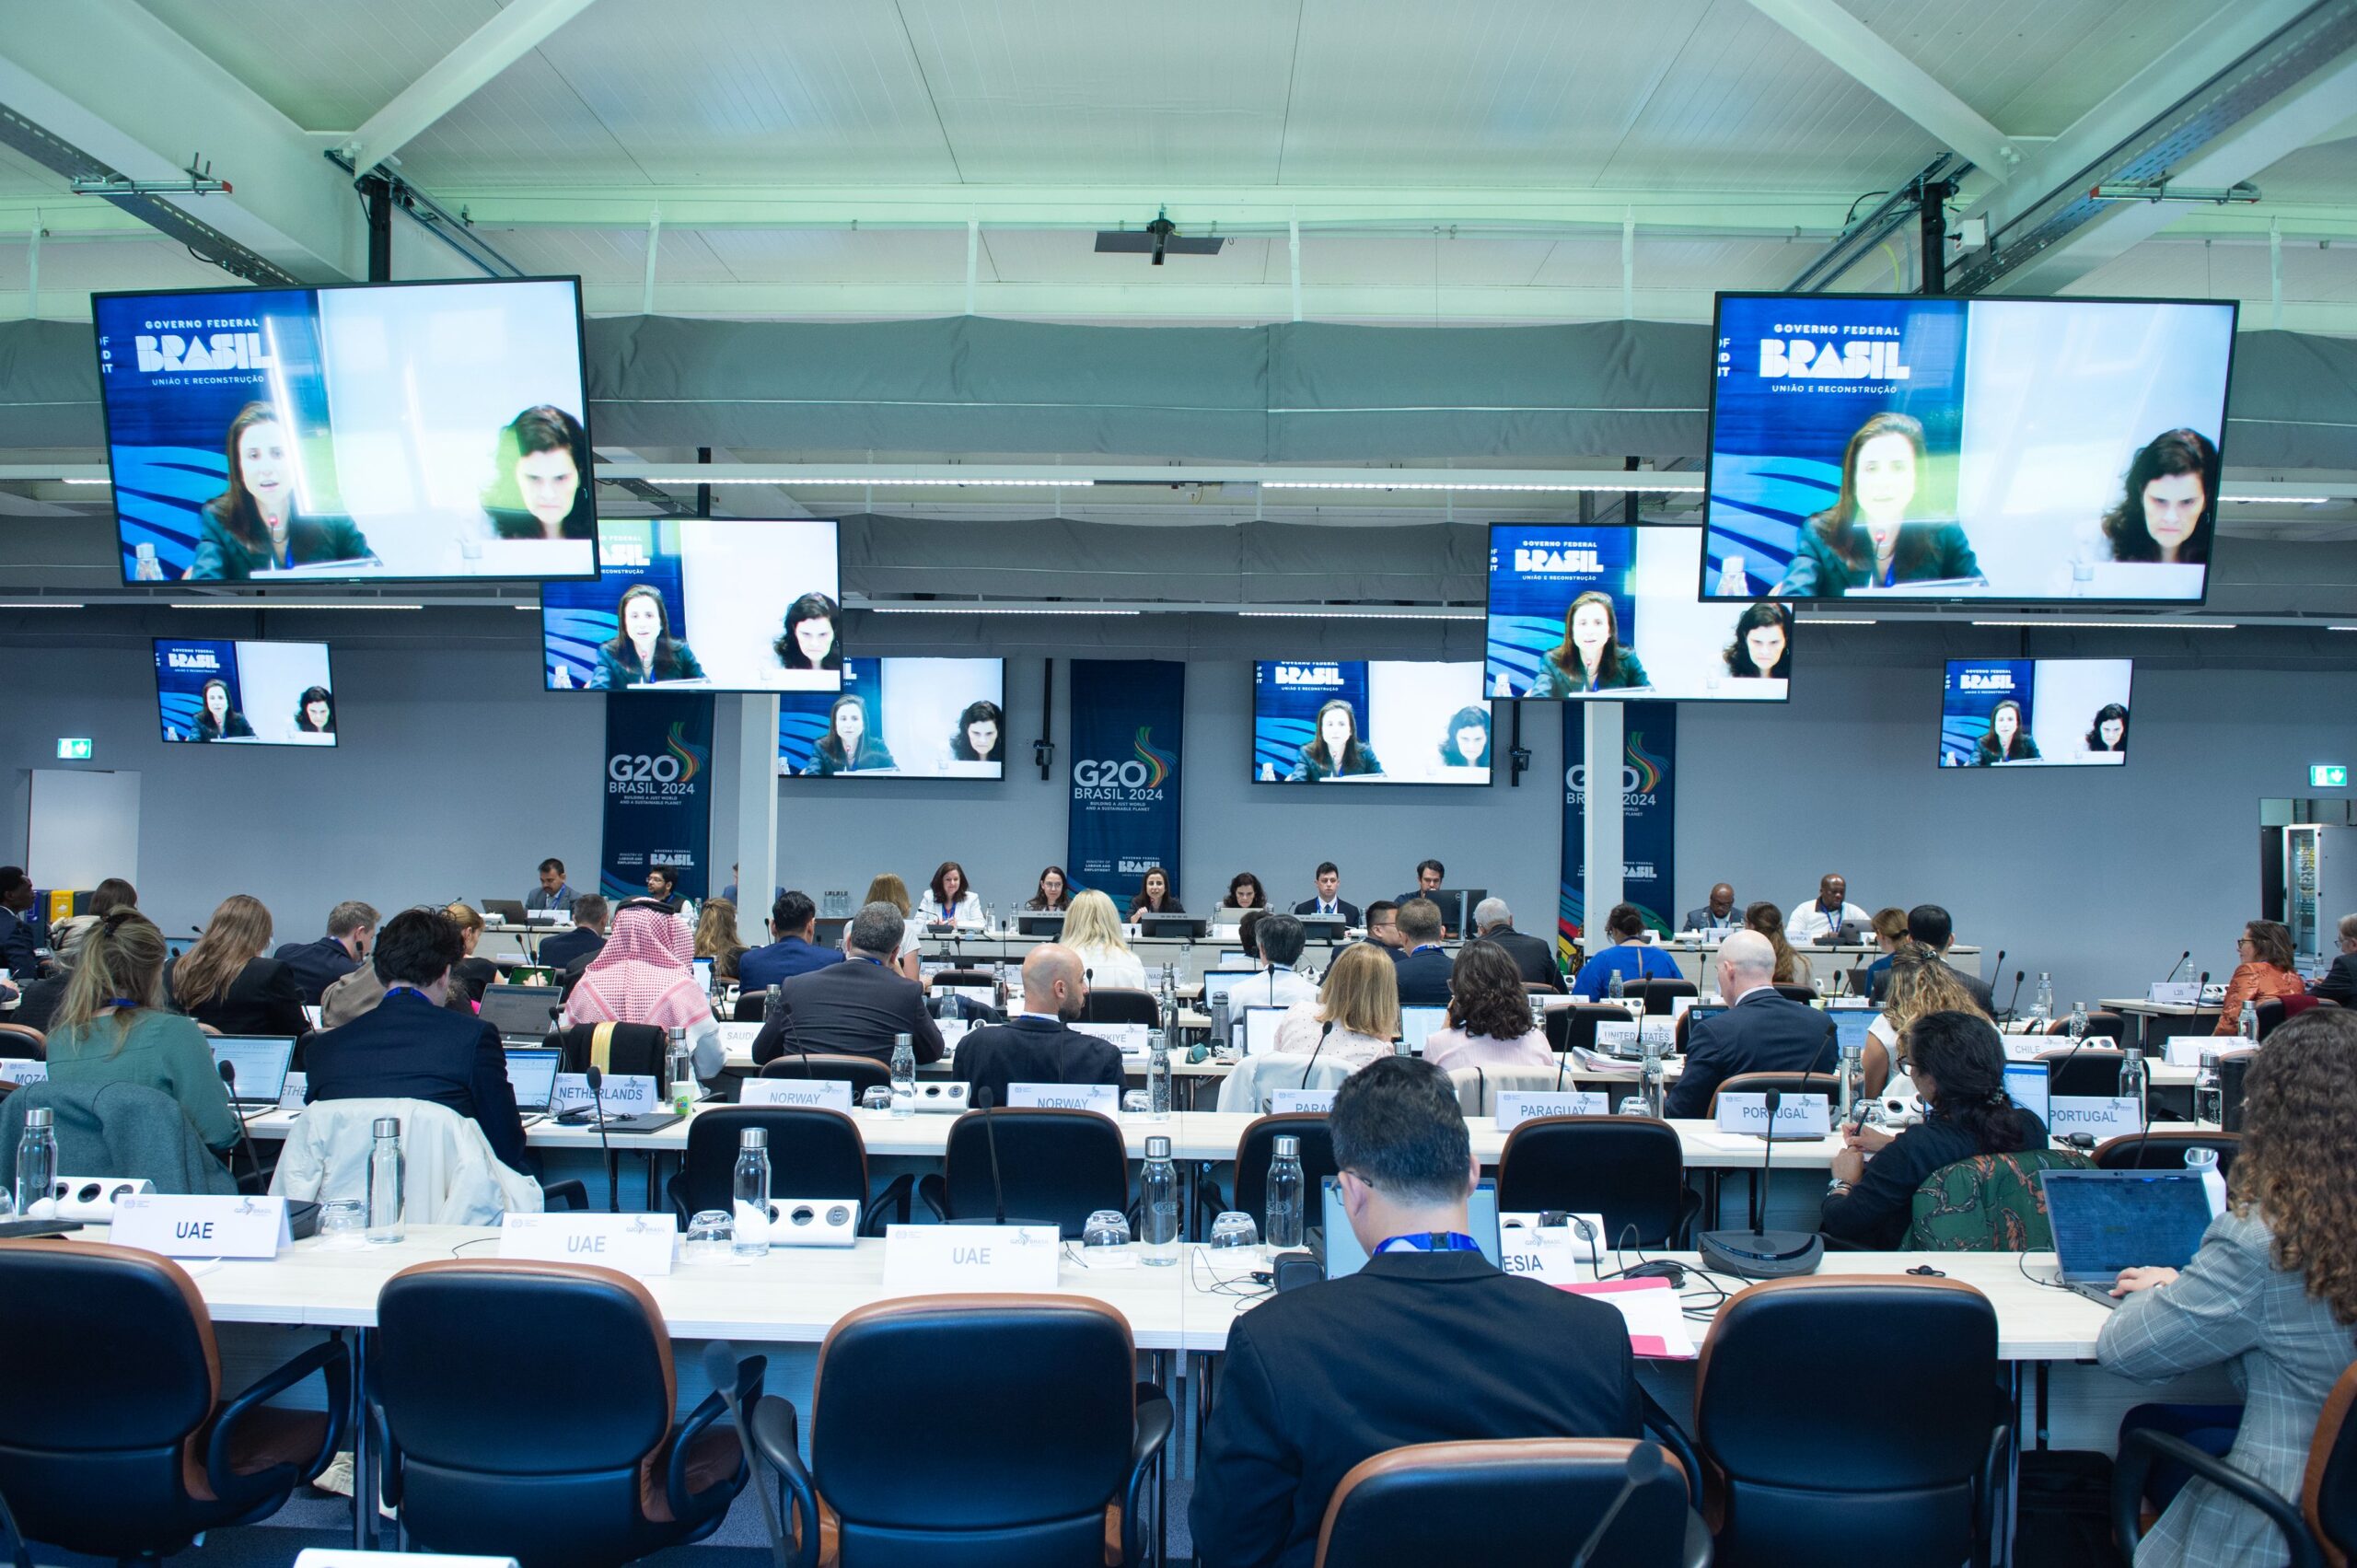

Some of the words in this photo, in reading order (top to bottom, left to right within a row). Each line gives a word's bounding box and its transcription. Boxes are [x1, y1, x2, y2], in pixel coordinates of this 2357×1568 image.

[145, 319, 203, 330] GOVERNO
[207, 319, 259, 328] FEDERAL
[1774, 324, 1839, 334] GOVERNO
[1843, 326, 1900, 336] FEDERAL
[135, 332, 274, 372] BRASIL
[1759, 338, 1910, 379] BRASIL
[152, 377, 180, 386] UNIÃO
[192, 375, 264, 385] RECONSTRUÇÃO
[1771, 384, 1805, 392] UNIÃO
[1817, 385, 1898, 395] RECONSTRUÇÃO
[1515, 549, 1604, 573] BRASIL
[168, 653, 220, 668] BRASIL
[1275, 666, 1344, 685] BRASIL
[1960, 674, 2015, 689] BRASIL
[610, 754, 679, 783] G20
[1074, 760, 1147, 788] G20
[610, 782, 656, 794] BRASIL
[661, 783, 695, 795] 2024
[1074, 787, 1124, 800] BRASIL
[1129, 789, 1164, 800] 2024
[1622, 794, 1656, 806] 2024
[650, 854, 694, 865] BRASIL
[1623, 865, 1657, 877] RASIL
[727, 1031, 754, 1040] SAUDI
[1604, 1031, 1635, 1040] UNITED
[1640, 1032, 1670, 1041] STATES
[2015, 1045, 2040, 1053] CHILE
[770, 1092, 820, 1104] NORWAY
[1038, 1098, 1089, 1110] NORWAY
[1521, 1105, 1586, 1116] PARAGUAY
[1743, 1107, 1808, 1119] PORUGAL
[2050, 1109, 2118, 1122] PORTUGAL
[176, 1222, 214, 1238] UAE
[567, 1236, 606, 1252] UAE
[953, 1248, 991, 1264] UAE
[1503, 1255, 1544, 1272] ESIA
